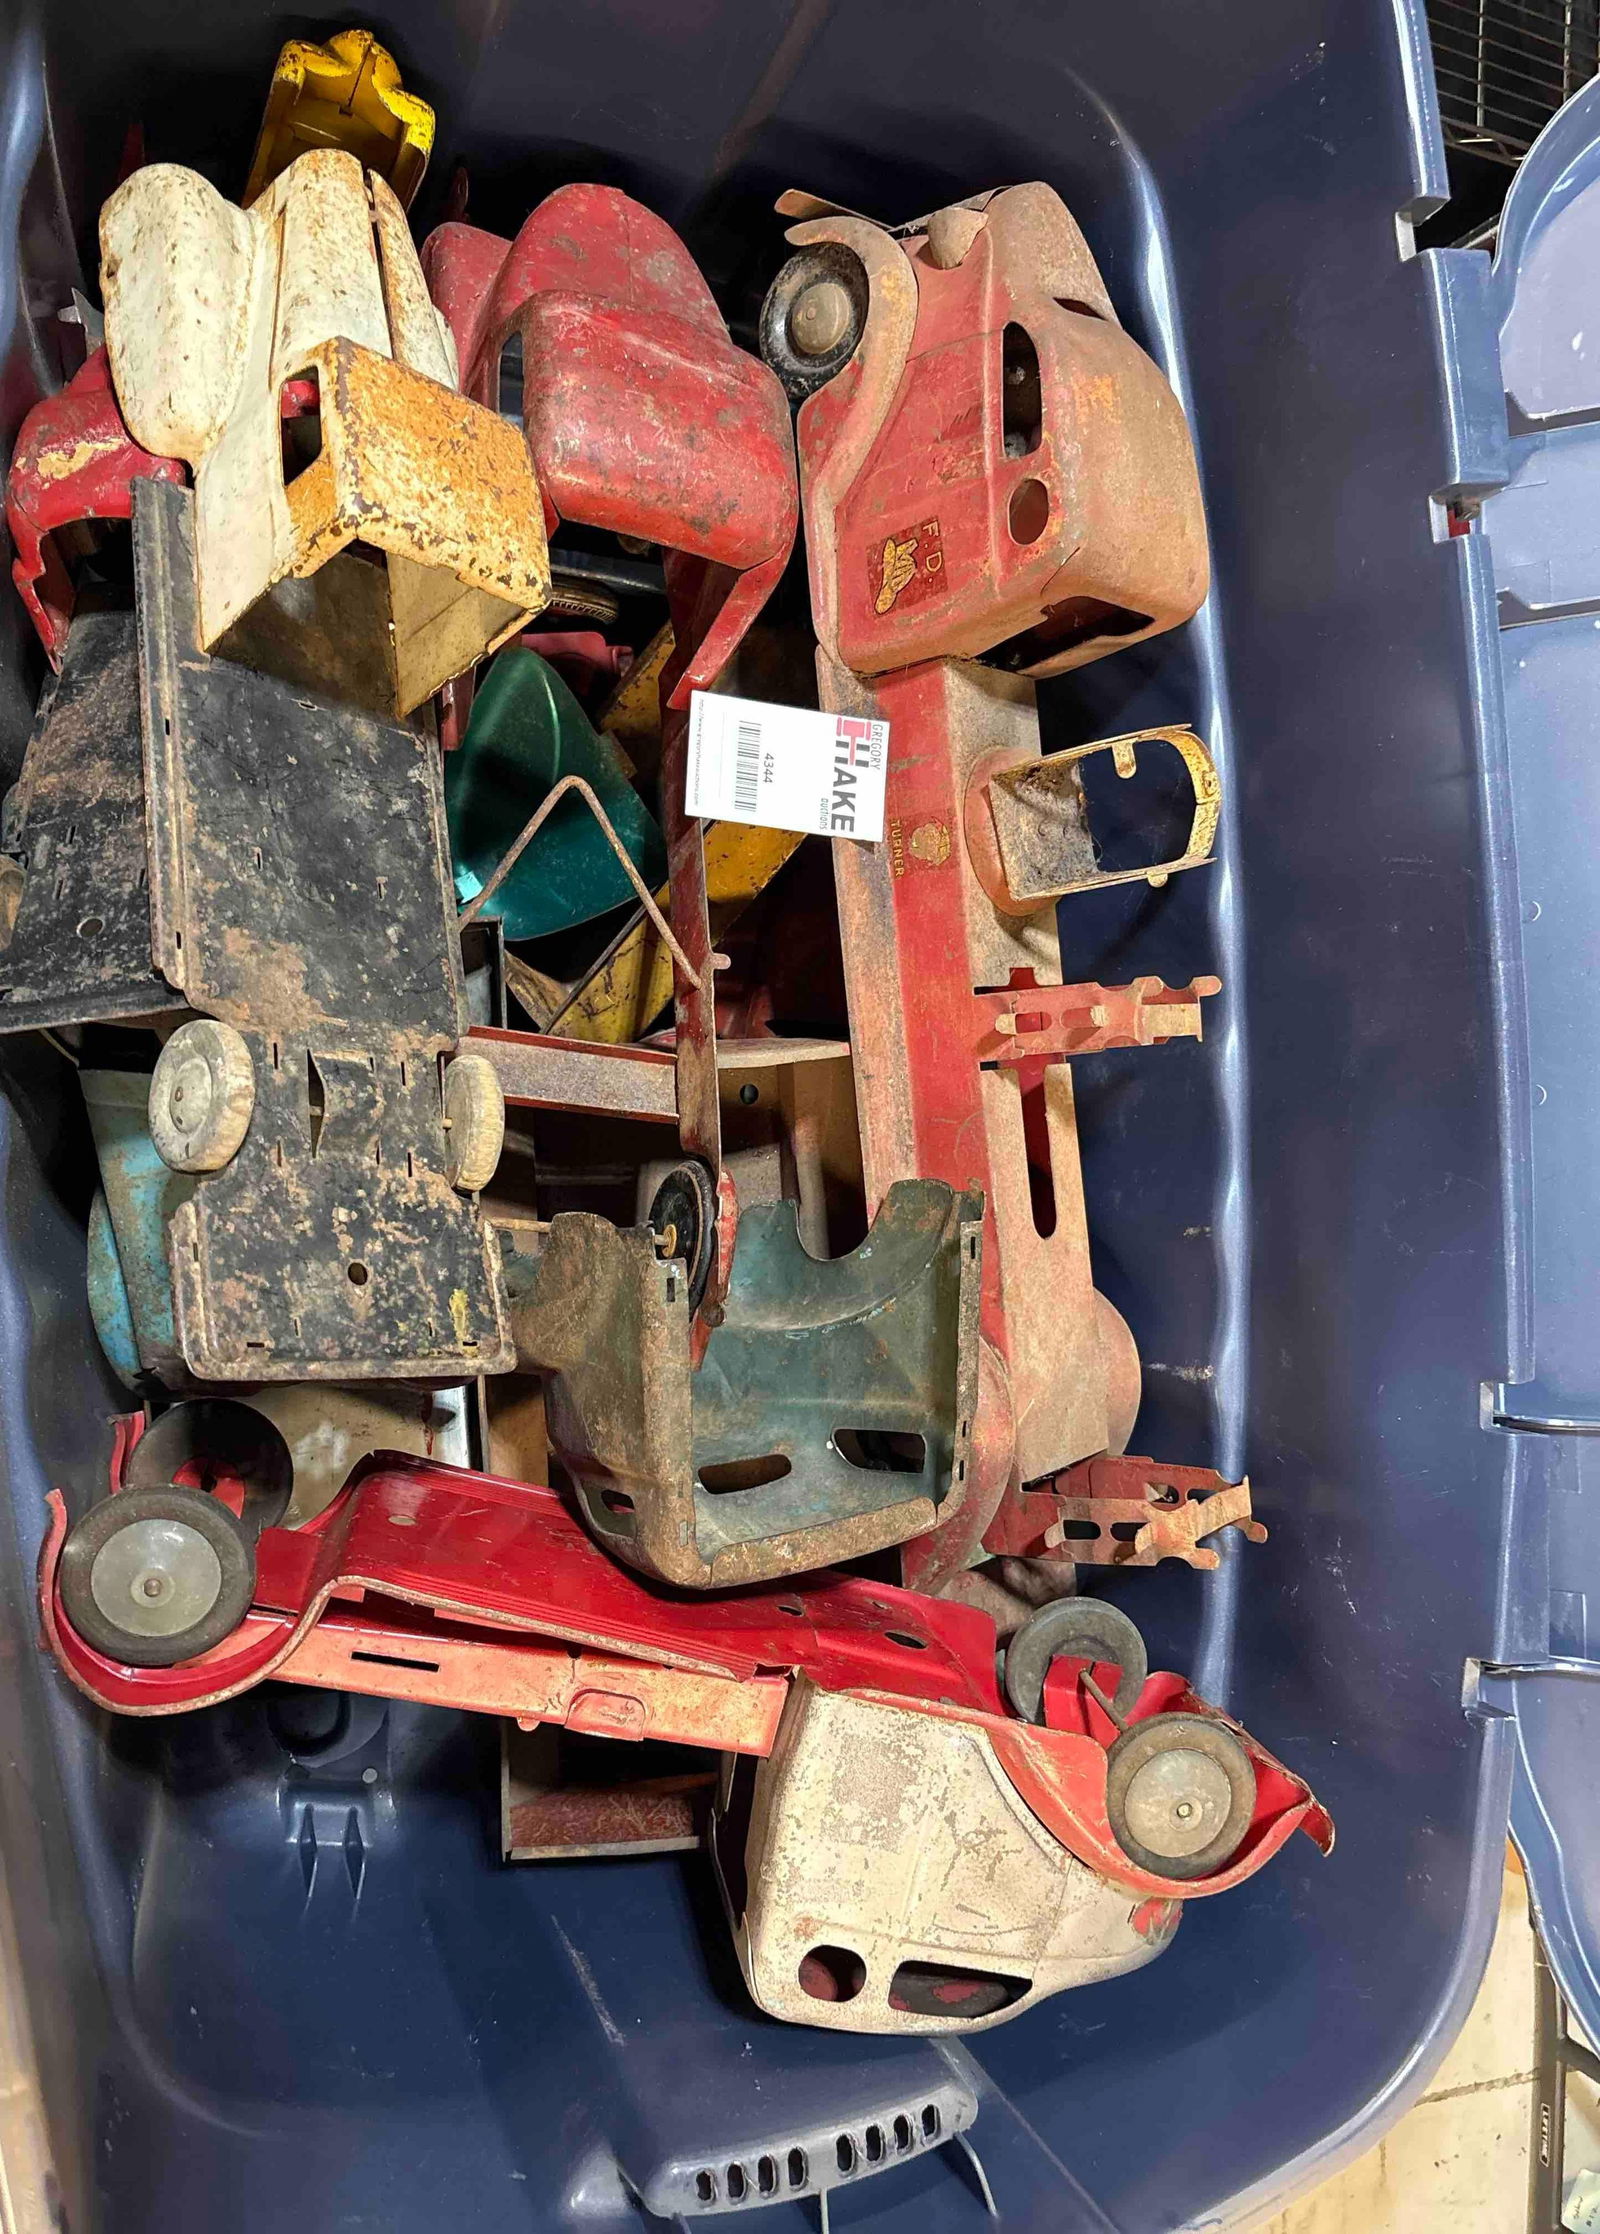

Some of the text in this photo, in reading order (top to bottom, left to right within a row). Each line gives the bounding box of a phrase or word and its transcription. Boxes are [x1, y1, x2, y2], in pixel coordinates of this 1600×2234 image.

[762, 752, 775, 783] 4344
[869, 724, 884, 770] GREGORY
[830, 738, 871, 833] HAKE
[819, 797, 829, 830] auctions
[890, 820, 905, 877] TURNER
